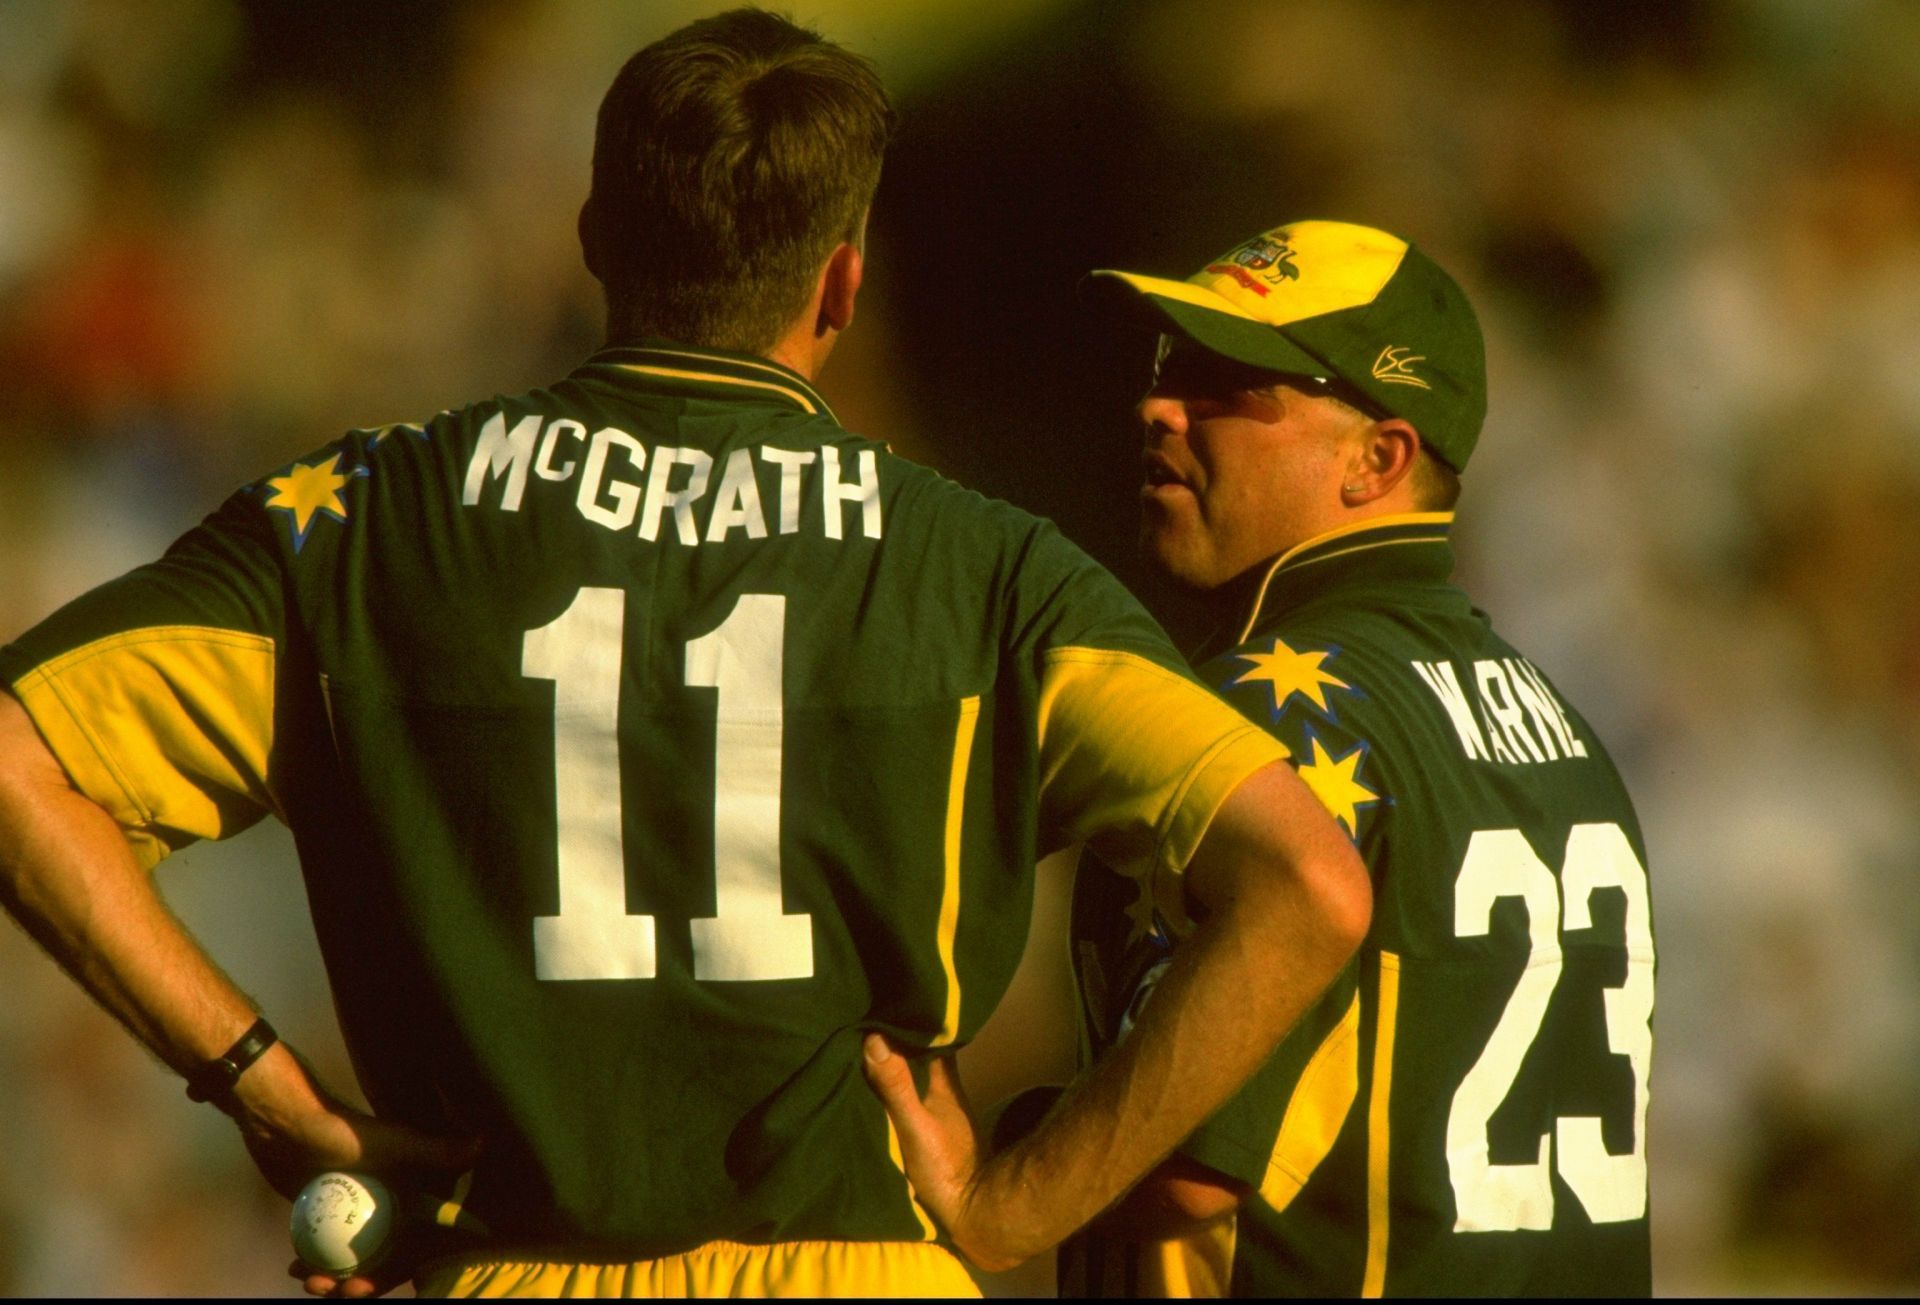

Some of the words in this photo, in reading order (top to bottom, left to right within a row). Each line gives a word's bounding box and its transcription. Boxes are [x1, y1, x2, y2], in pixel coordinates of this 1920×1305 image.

[462, 411, 882, 546] McGRATH
[521, 586, 814, 981] 11
[1446, 822, 1655, 1233] 23
